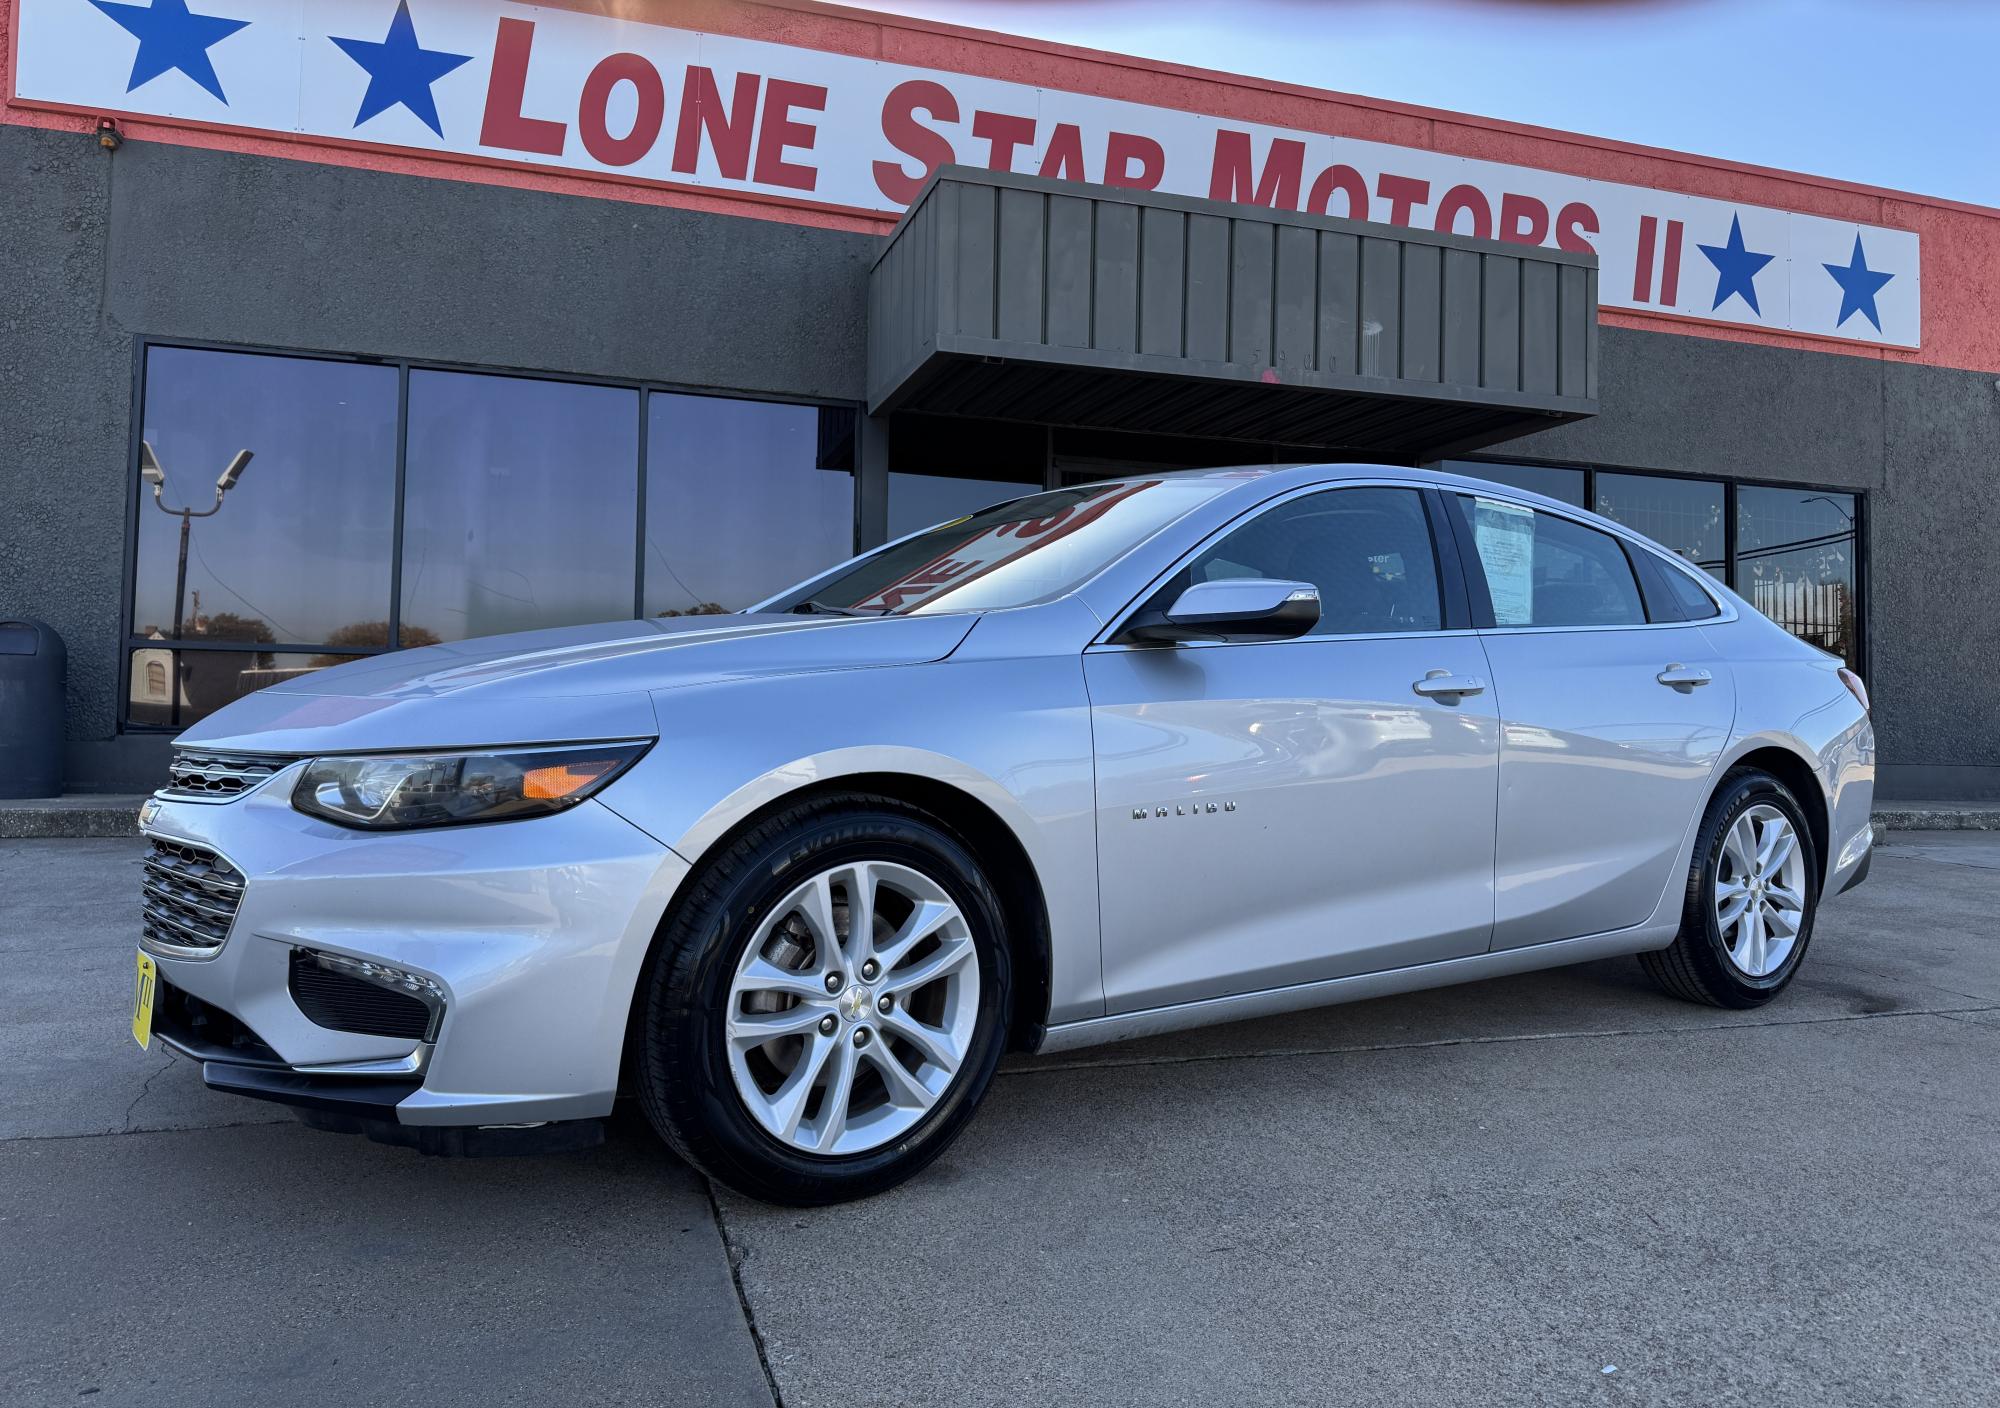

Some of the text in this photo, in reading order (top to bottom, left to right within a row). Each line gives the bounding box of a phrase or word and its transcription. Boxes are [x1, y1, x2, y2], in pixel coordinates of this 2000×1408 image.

[480, 18, 1684, 307] LONE STAR MOTORS II
[1132, 800, 1237, 820] MALIBU
